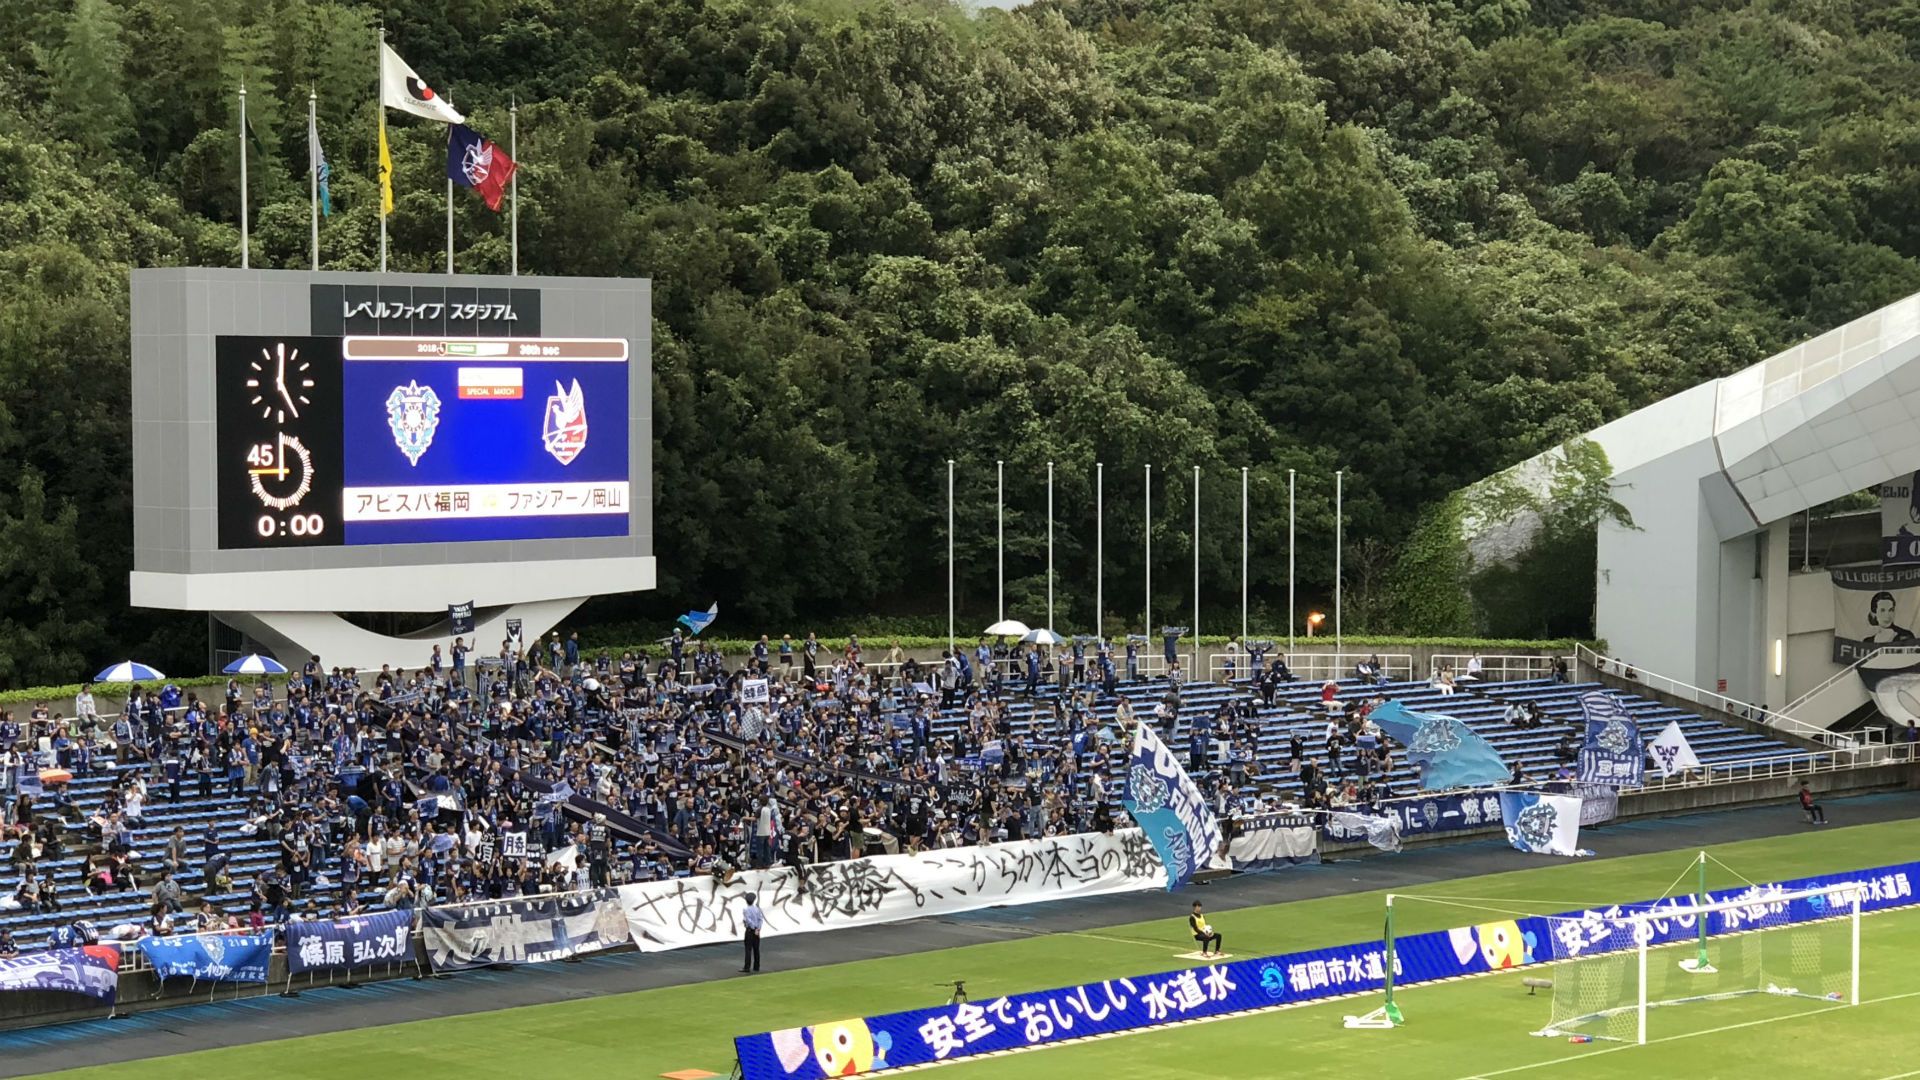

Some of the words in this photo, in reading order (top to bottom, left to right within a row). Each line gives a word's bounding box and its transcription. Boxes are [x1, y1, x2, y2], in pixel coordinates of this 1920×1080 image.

[451, 303, 518, 321] スタジアム
[493, 387, 515, 396] MATCH
[247, 444, 274, 466] 45
[356, 491, 470, 513] アビスパ福岡
[508, 487, 621, 509] ファジアーノ岡山
[258, 514, 324, 537] 0:00
[353, 926, 409, 963] 弘次郎
[527, 947, 573, 963] ULTRA
